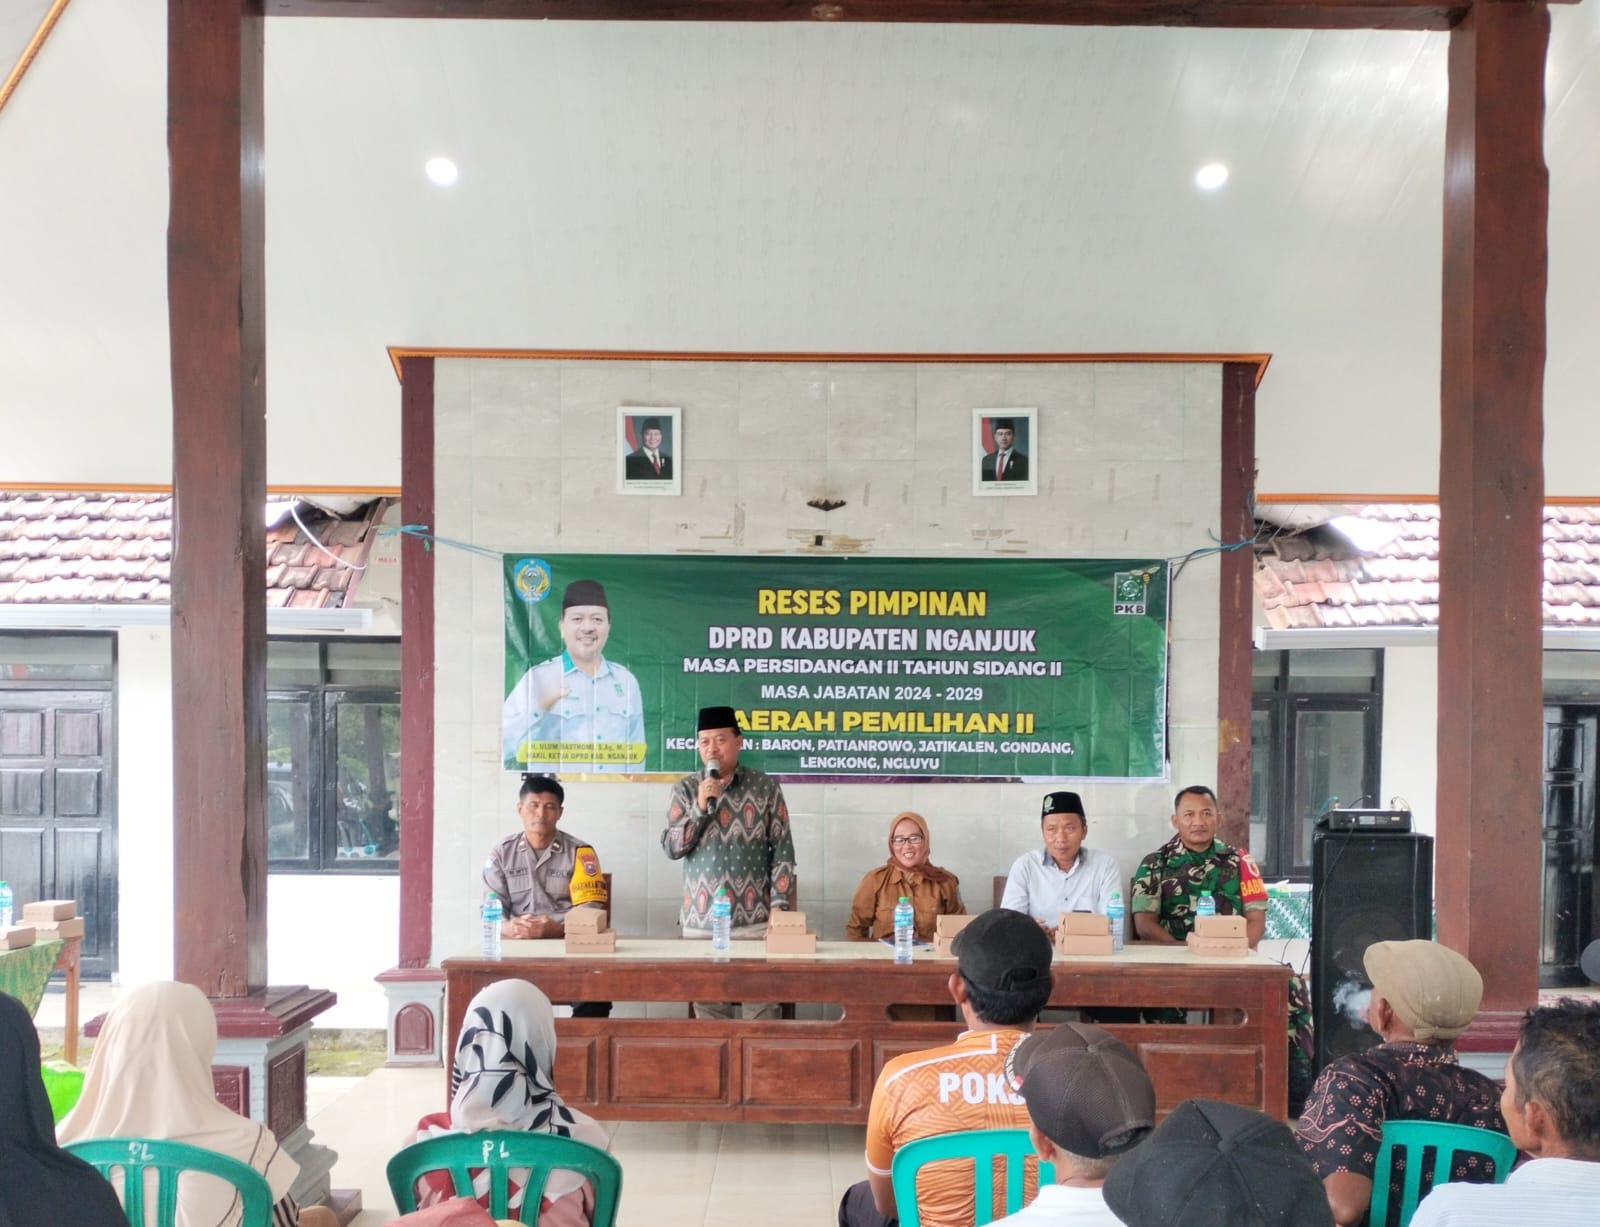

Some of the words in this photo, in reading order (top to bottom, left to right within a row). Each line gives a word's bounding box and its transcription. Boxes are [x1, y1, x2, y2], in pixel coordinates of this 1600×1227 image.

[758, 589, 841, 615] RESES
[850, 590, 986, 617] PIMPINAN
[1114, 604, 1145, 614] PKB
[709, 626, 773, 649] DPRD
[780, 627, 918, 651] KABUPATEN
[925, 629, 1036, 652] NGANJUK
[683, 657, 741, 673] MASA
[743, 658, 883, 674] PERSIDANGAN
[887, 660, 899, 674] II
[901, 660, 969, 675] TAHUN
[972, 661, 1047, 676] SIDANG
[1050, 662, 1062, 676] II
[761, 684, 810, 699] MASA
[813, 685, 890, 700] JABATAN
[894, 687, 932, 700] 2024
[945, 687, 983, 701] 2029
[734, 710, 836, 732] AERAH
[842, 711, 1009, 734] PEMILIHAN
[1015, 713, 1034, 734] II
[761, 738, 816, 753] BARON,
[817, 739, 917, 754] PATIANROWO,
[918, 740, 998, 754] JATIKALEN,
[1000, 741, 1075, 755] GONDANG,
[800, 756, 881, 770] LENGKONG,
[882, 757, 940, 770] NGLUYU
